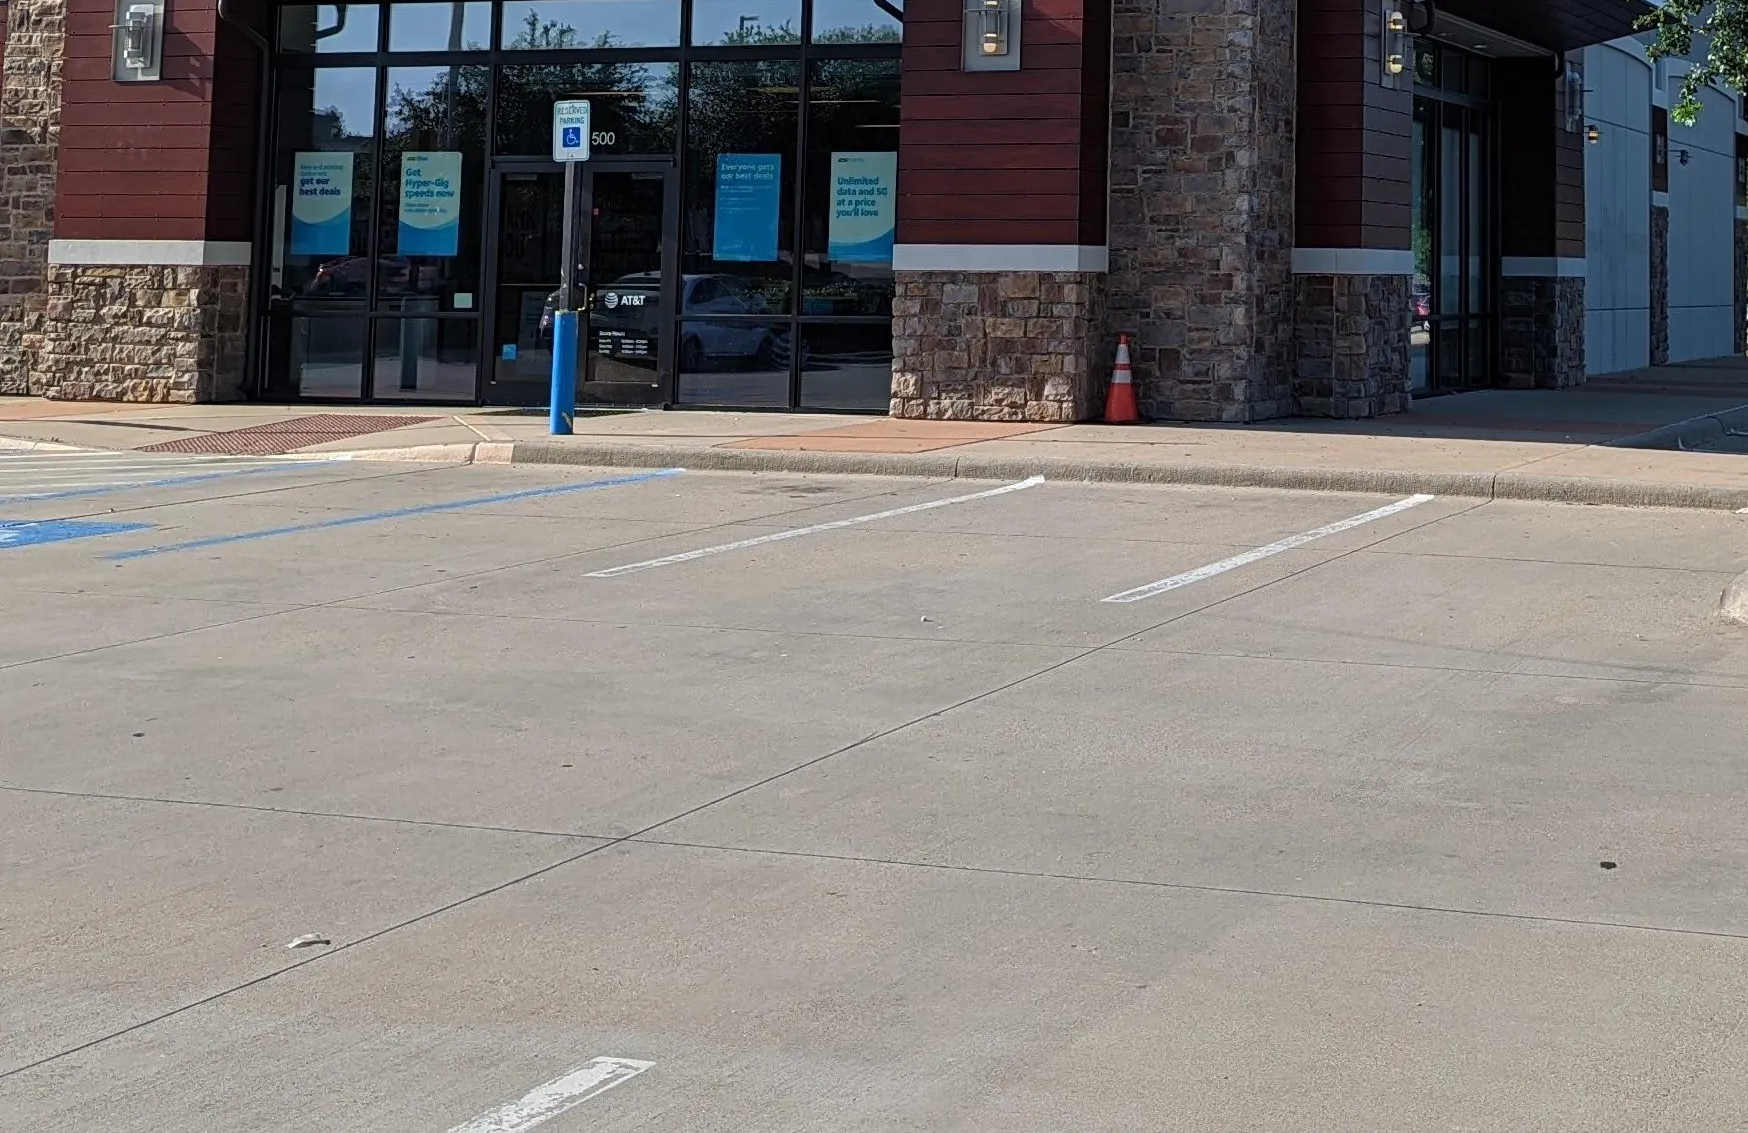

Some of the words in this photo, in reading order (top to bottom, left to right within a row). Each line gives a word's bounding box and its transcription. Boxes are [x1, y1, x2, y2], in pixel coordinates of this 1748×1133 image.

[560, 117, 585, 125] PARKING
[592, 132, 615, 145] 500
[405, 168, 422, 177] Get
[404, 178, 449, 190] Hyper-Gig
[837, 176, 880, 186] Unlimited
[319, 187, 342, 196] deals
[404, 189, 434, 200] speeds
[435, 190, 455, 198] now
[836, 187, 857, 196] data
[858, 187, 875, 196] and
[876, 187, 888, 197] 5G
[836, 198, 846, 206] at
[854, 197, 877, 209] price
[860, 208, 879, 217] love
[621, 295, 646, 305] AT&T
